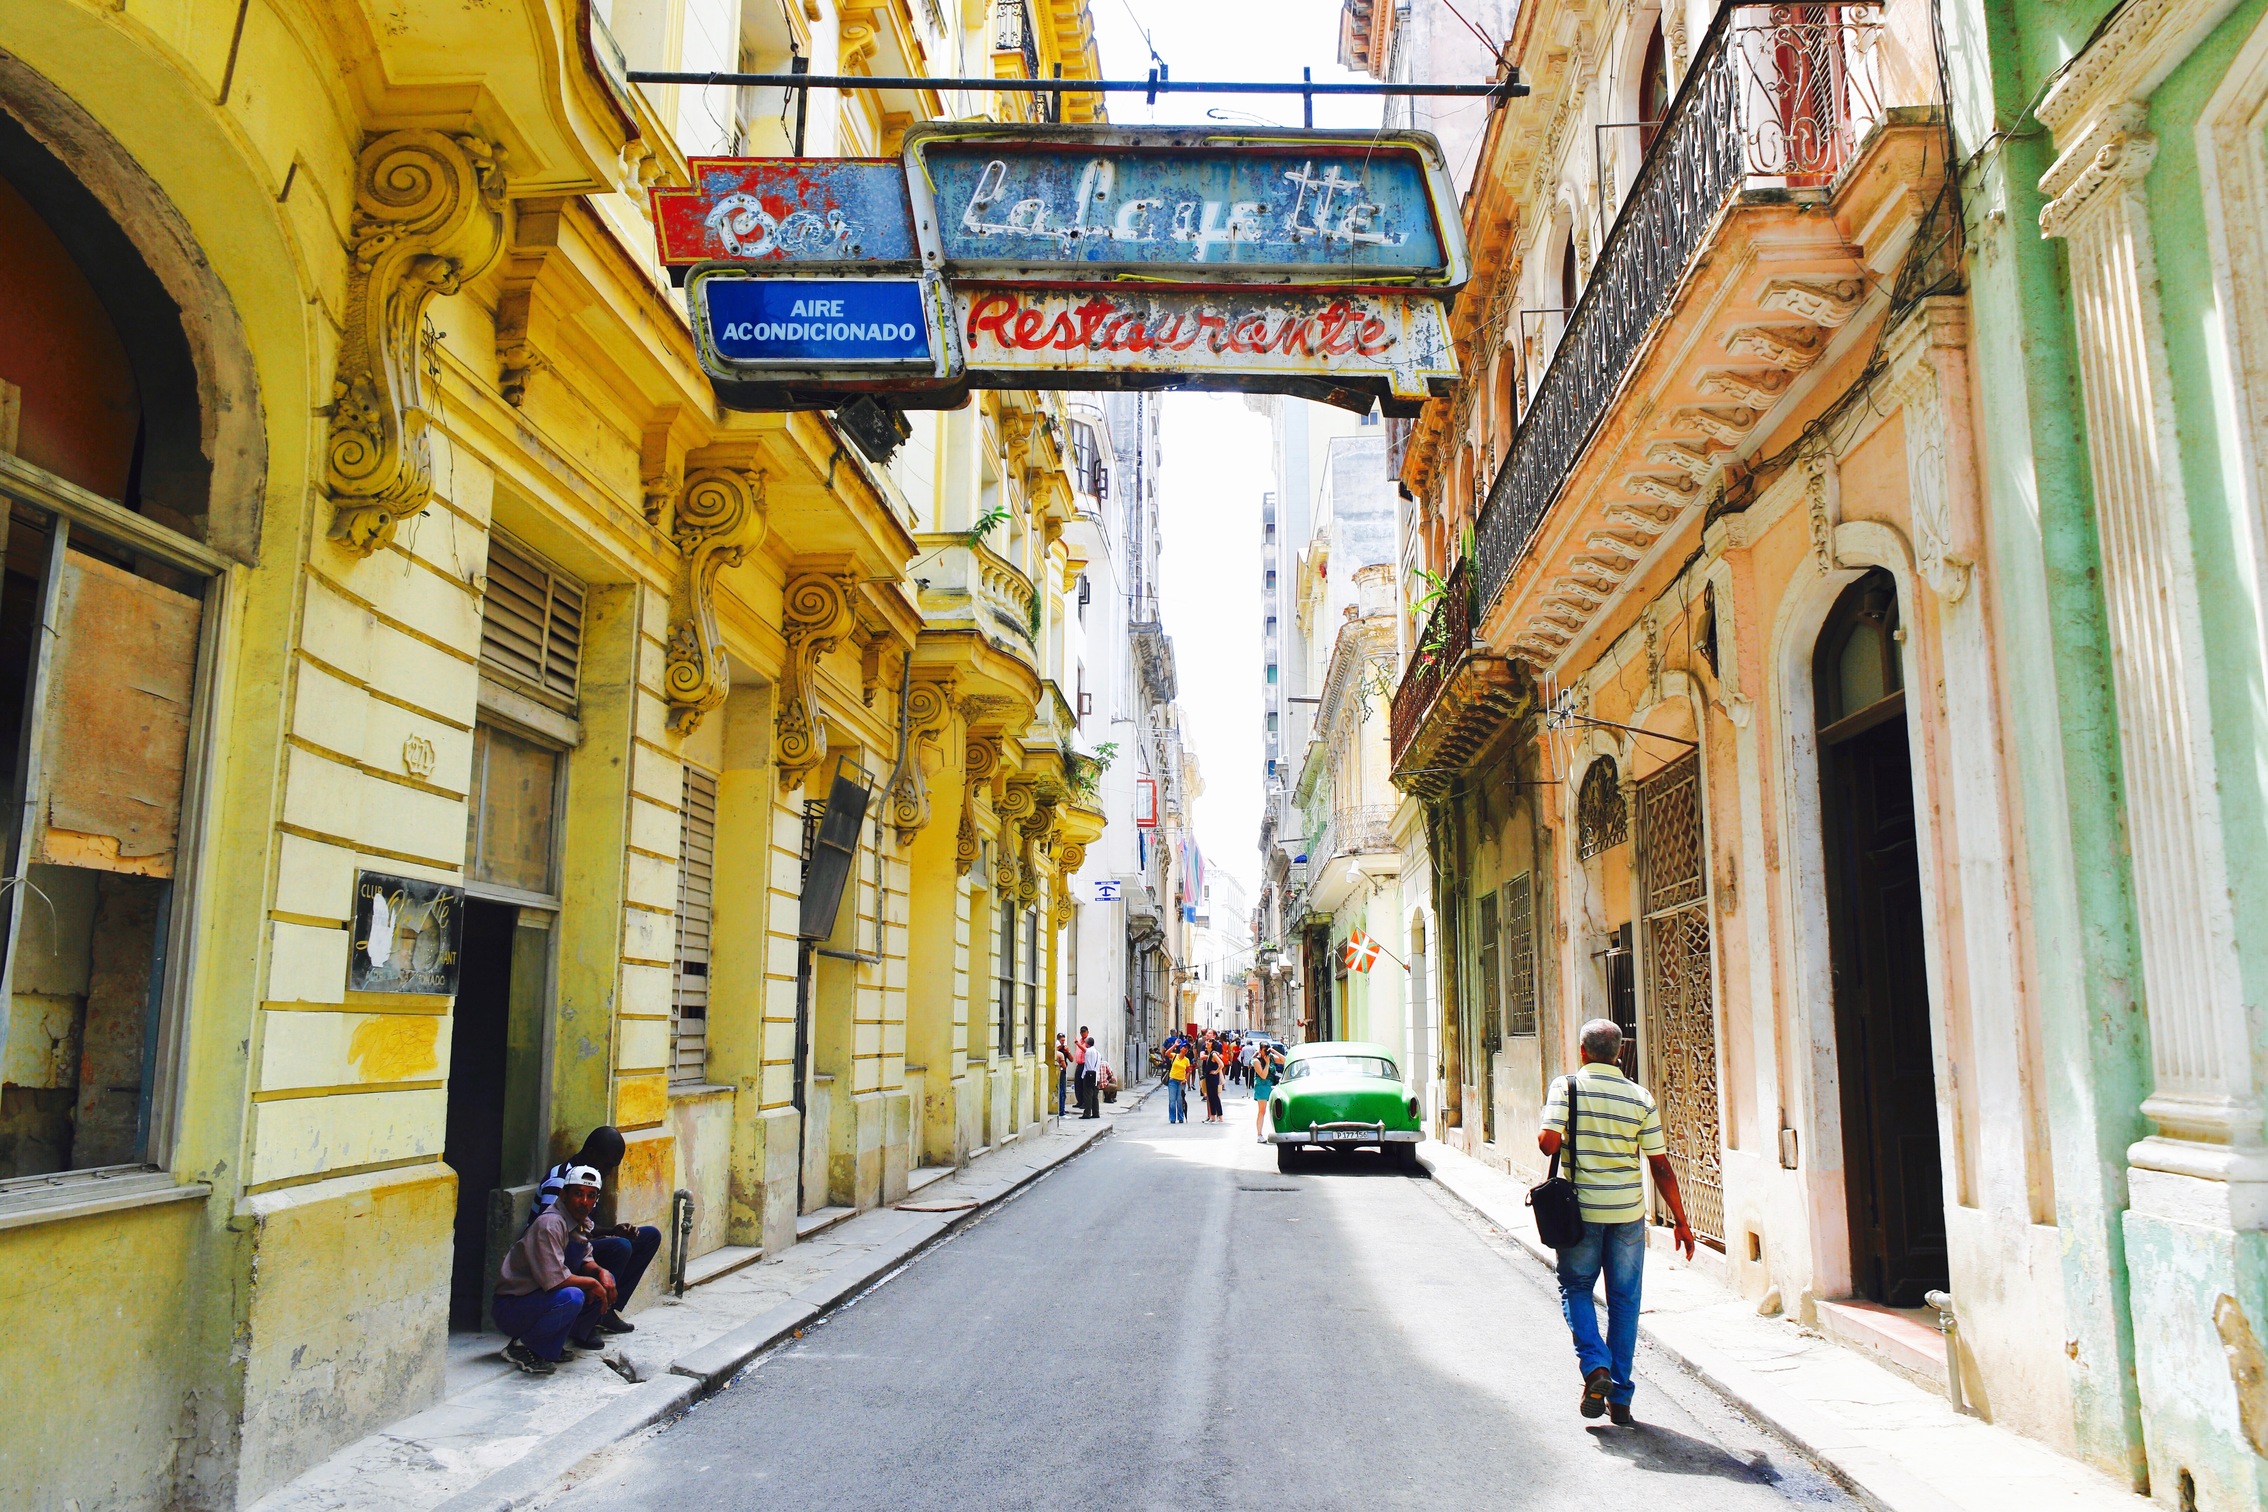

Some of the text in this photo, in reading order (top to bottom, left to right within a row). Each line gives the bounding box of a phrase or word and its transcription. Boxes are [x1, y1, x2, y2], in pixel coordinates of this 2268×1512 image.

[704, 193, 866, 258] Bar
[790, 299, 845, 318] AIRE
[966, 293, 1397, 357] Restaurante
[722, 321, 917, 342] ACONDICIONADO
